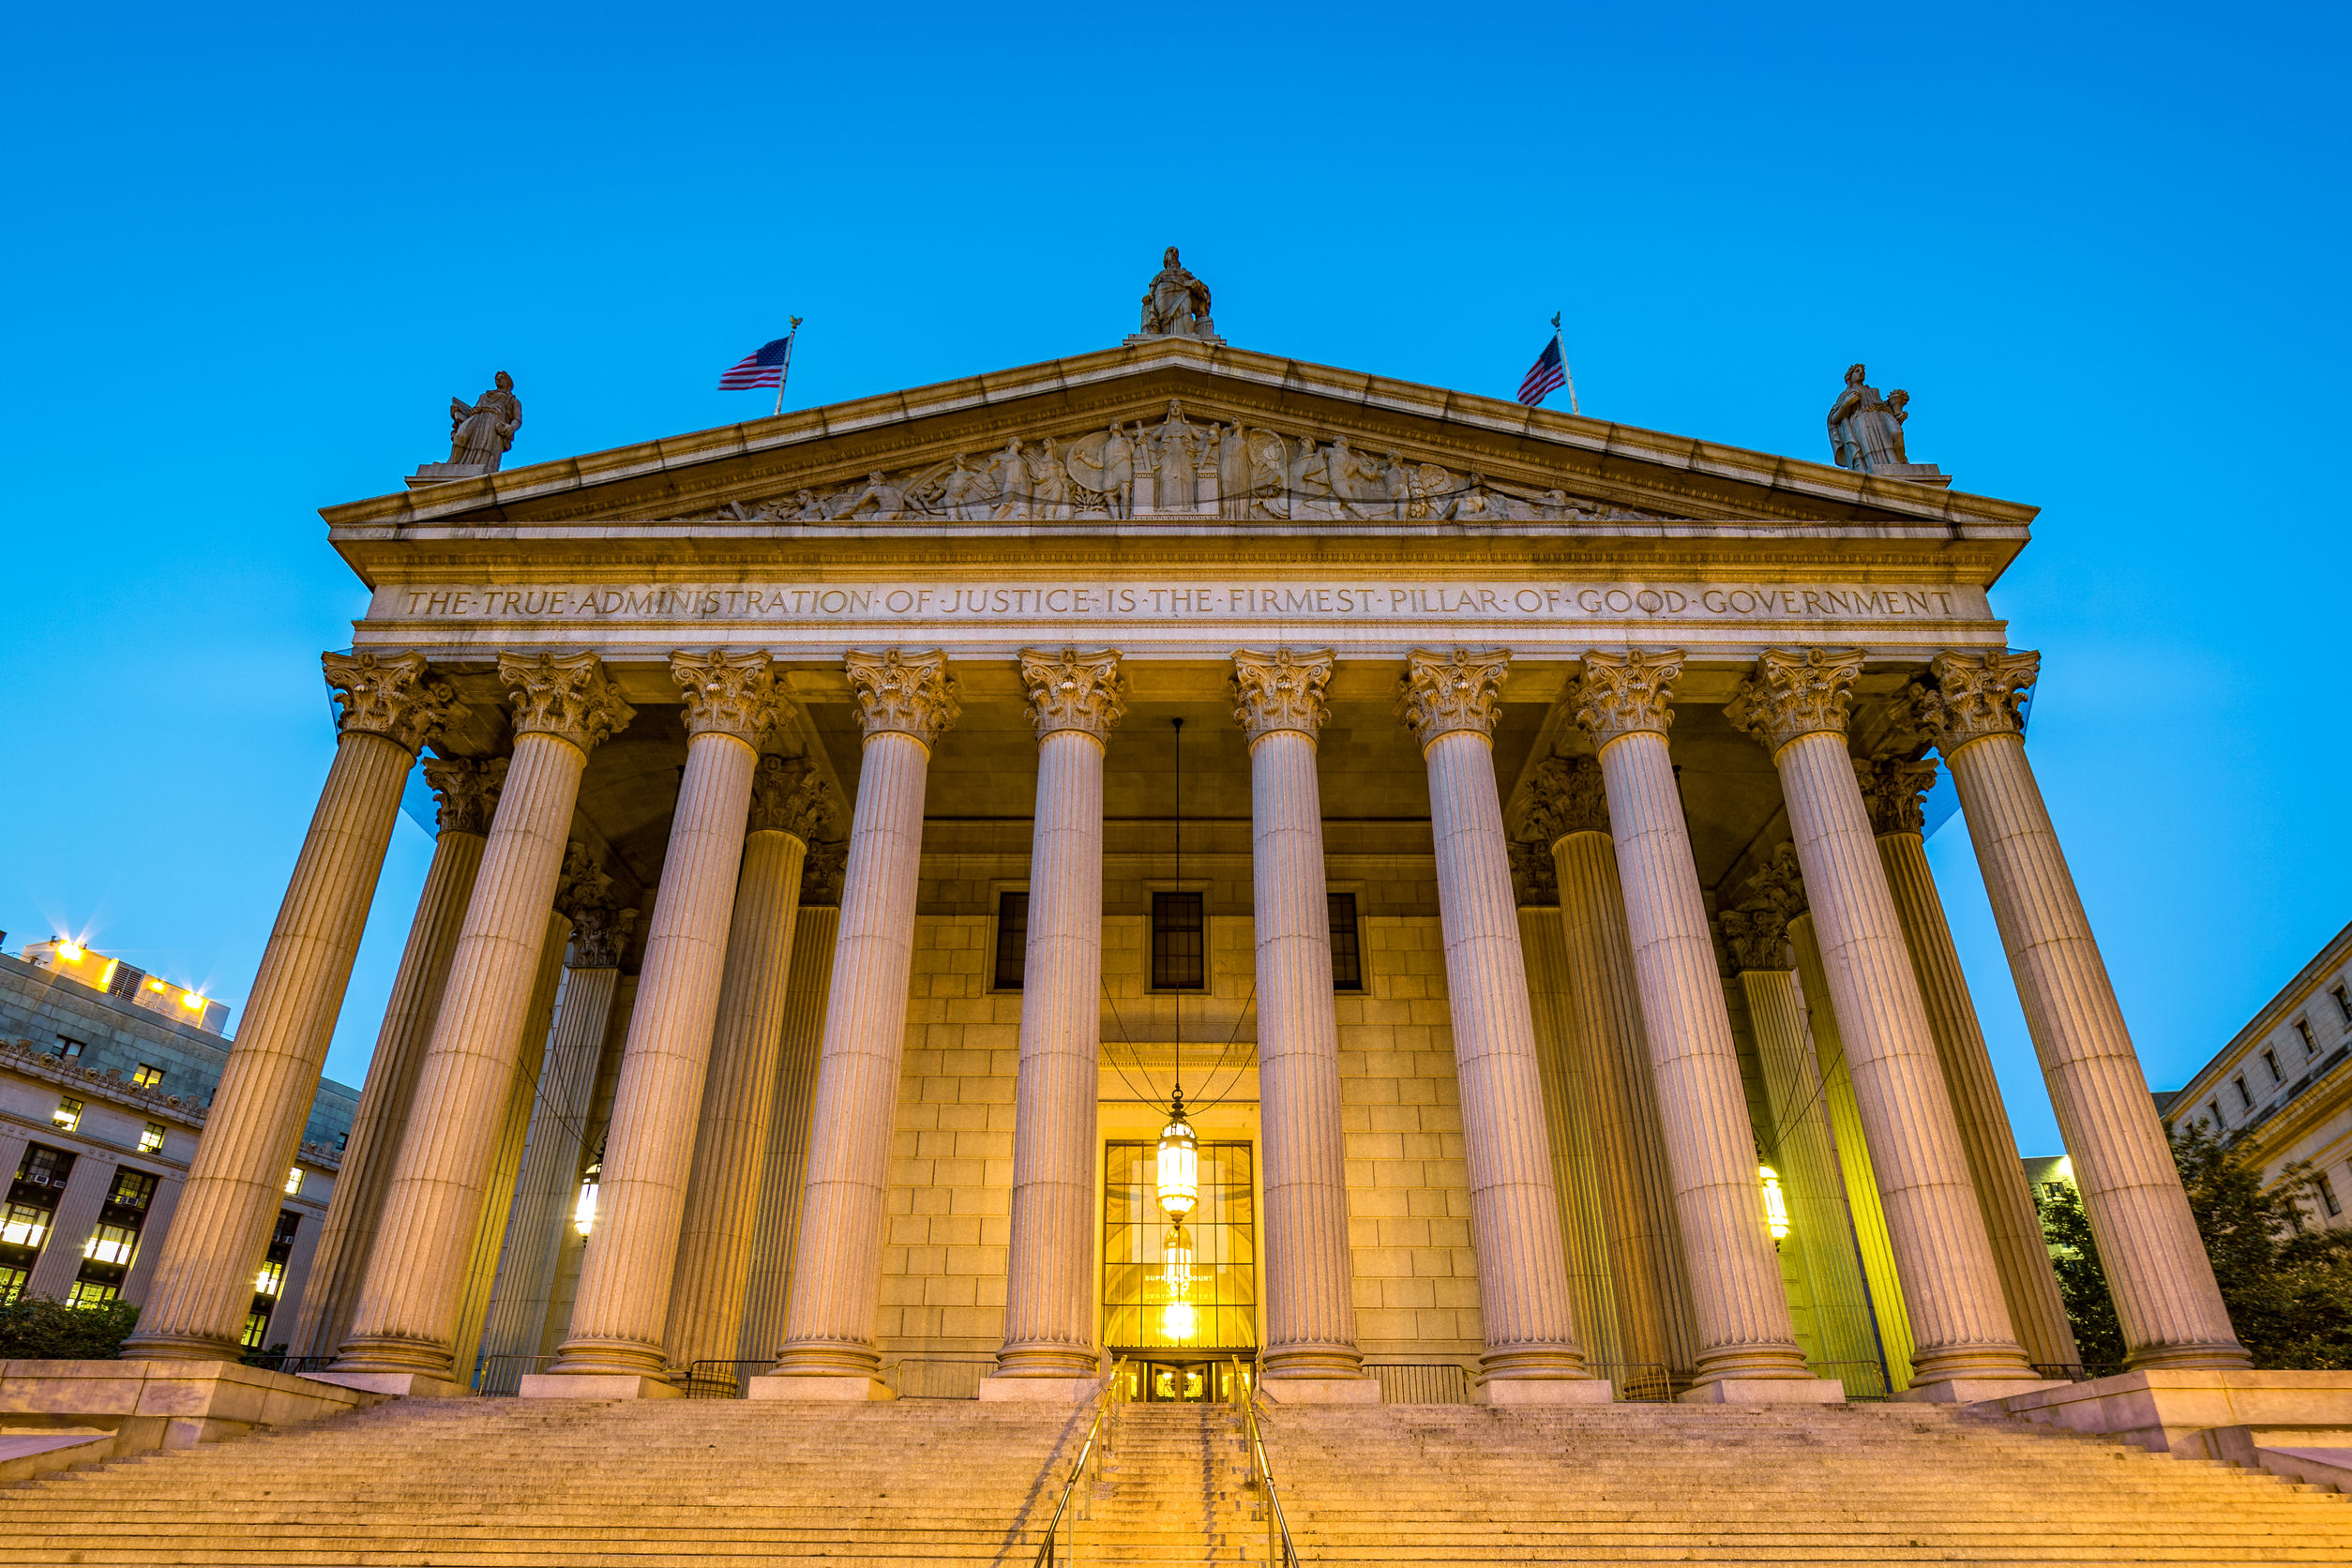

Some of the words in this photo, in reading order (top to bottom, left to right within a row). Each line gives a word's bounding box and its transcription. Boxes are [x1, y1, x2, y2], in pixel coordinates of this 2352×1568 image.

[408, 592, 471, 615] THE
[483, 591, 567, 615] TRUE
[574, 590, 872, 615] ADMINISTRATION
[885, 590, 933, 613] OF
[940, 589, 1091, 613] JUSTICE
[1106, 589, 1137, 613] IS
[1148, 589, 1214, 612] THE
[1229, 589, 1375, 612] FIRMEST
[1388, 589, 1507, 612] PILLAR
[1514, 589, 1560, 613] OF
[1576, 589, 1687, 614] GOOD
[1701, 590, 1952, 615] GOVERNMENT
